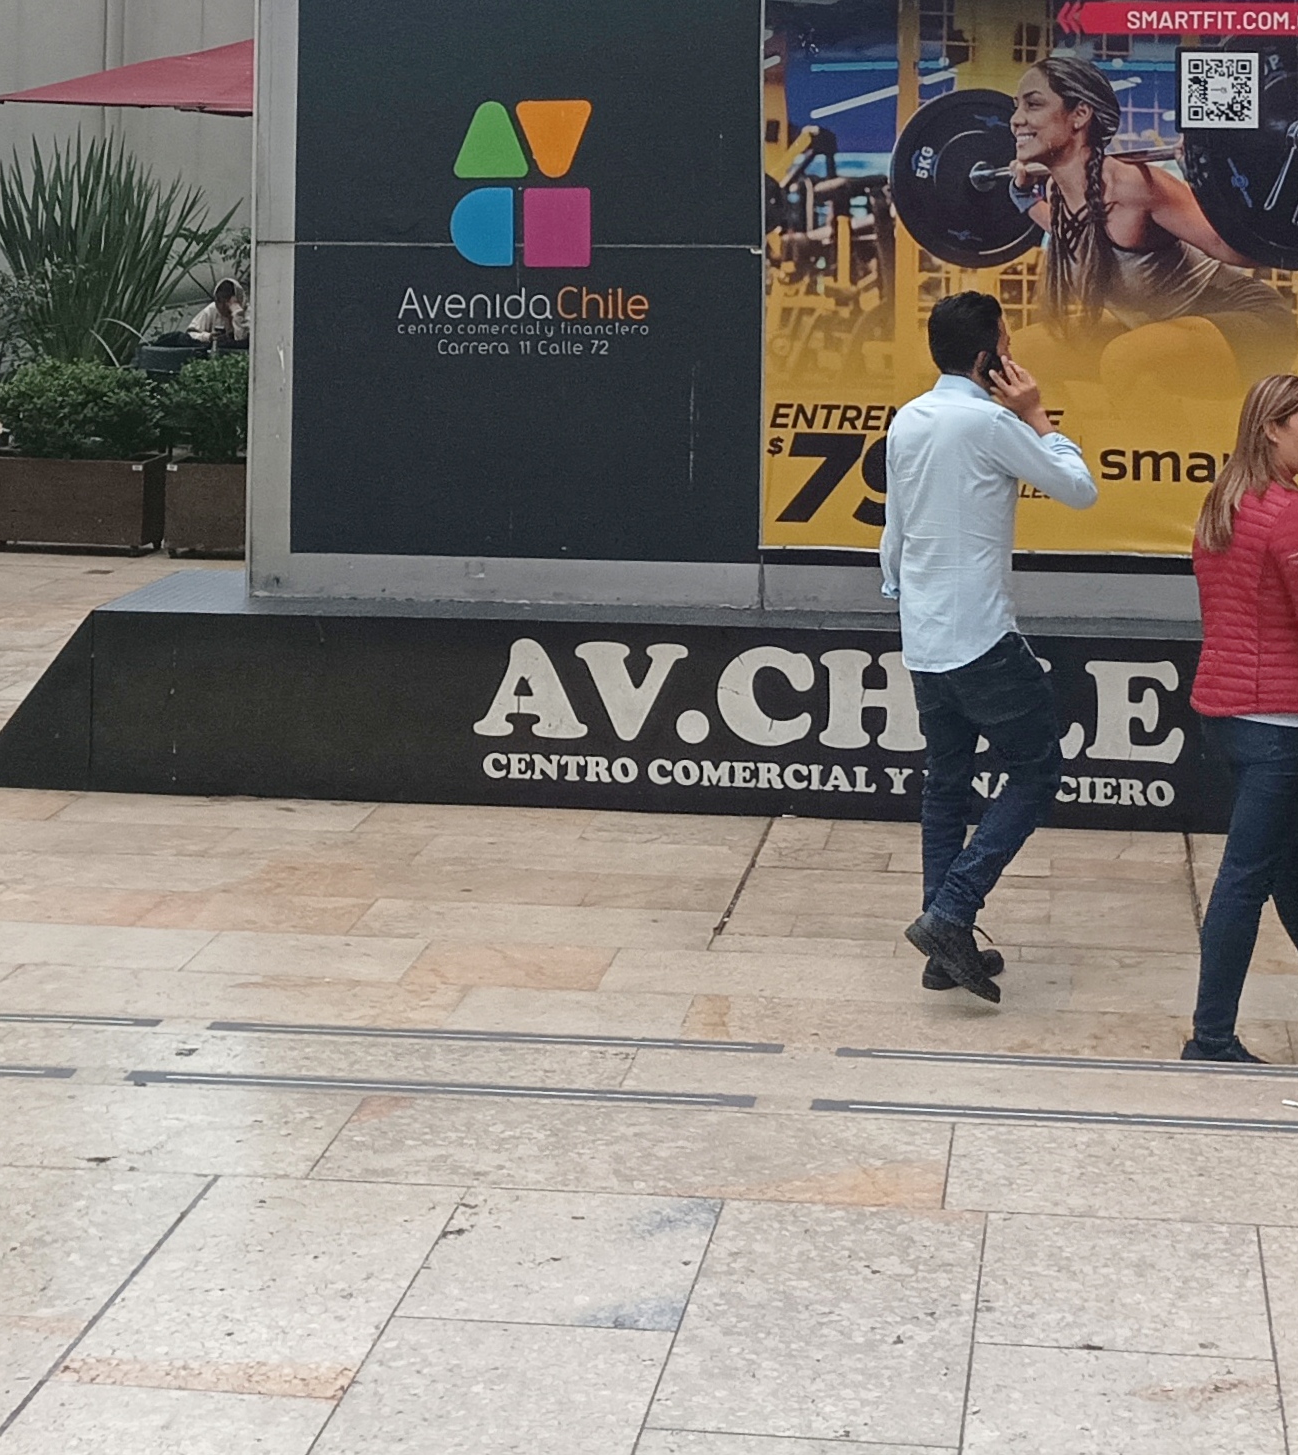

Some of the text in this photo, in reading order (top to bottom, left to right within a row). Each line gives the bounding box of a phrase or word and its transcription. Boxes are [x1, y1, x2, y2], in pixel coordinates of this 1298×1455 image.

[915, 146, 935, 179] 5KG
[397, 321, 650, 338] centro comercial y financiero
[437, 339, 610, 356] Carrera 11 Calle 72
[1099, 447, 1232, 484] sma
[472, 637, 1186, 765] AV.CHE
[482, 752, 639, 784] CENTRO
[647, 758, 877, 794] COMERCIAL
[884, 767, 914, 795] Y
